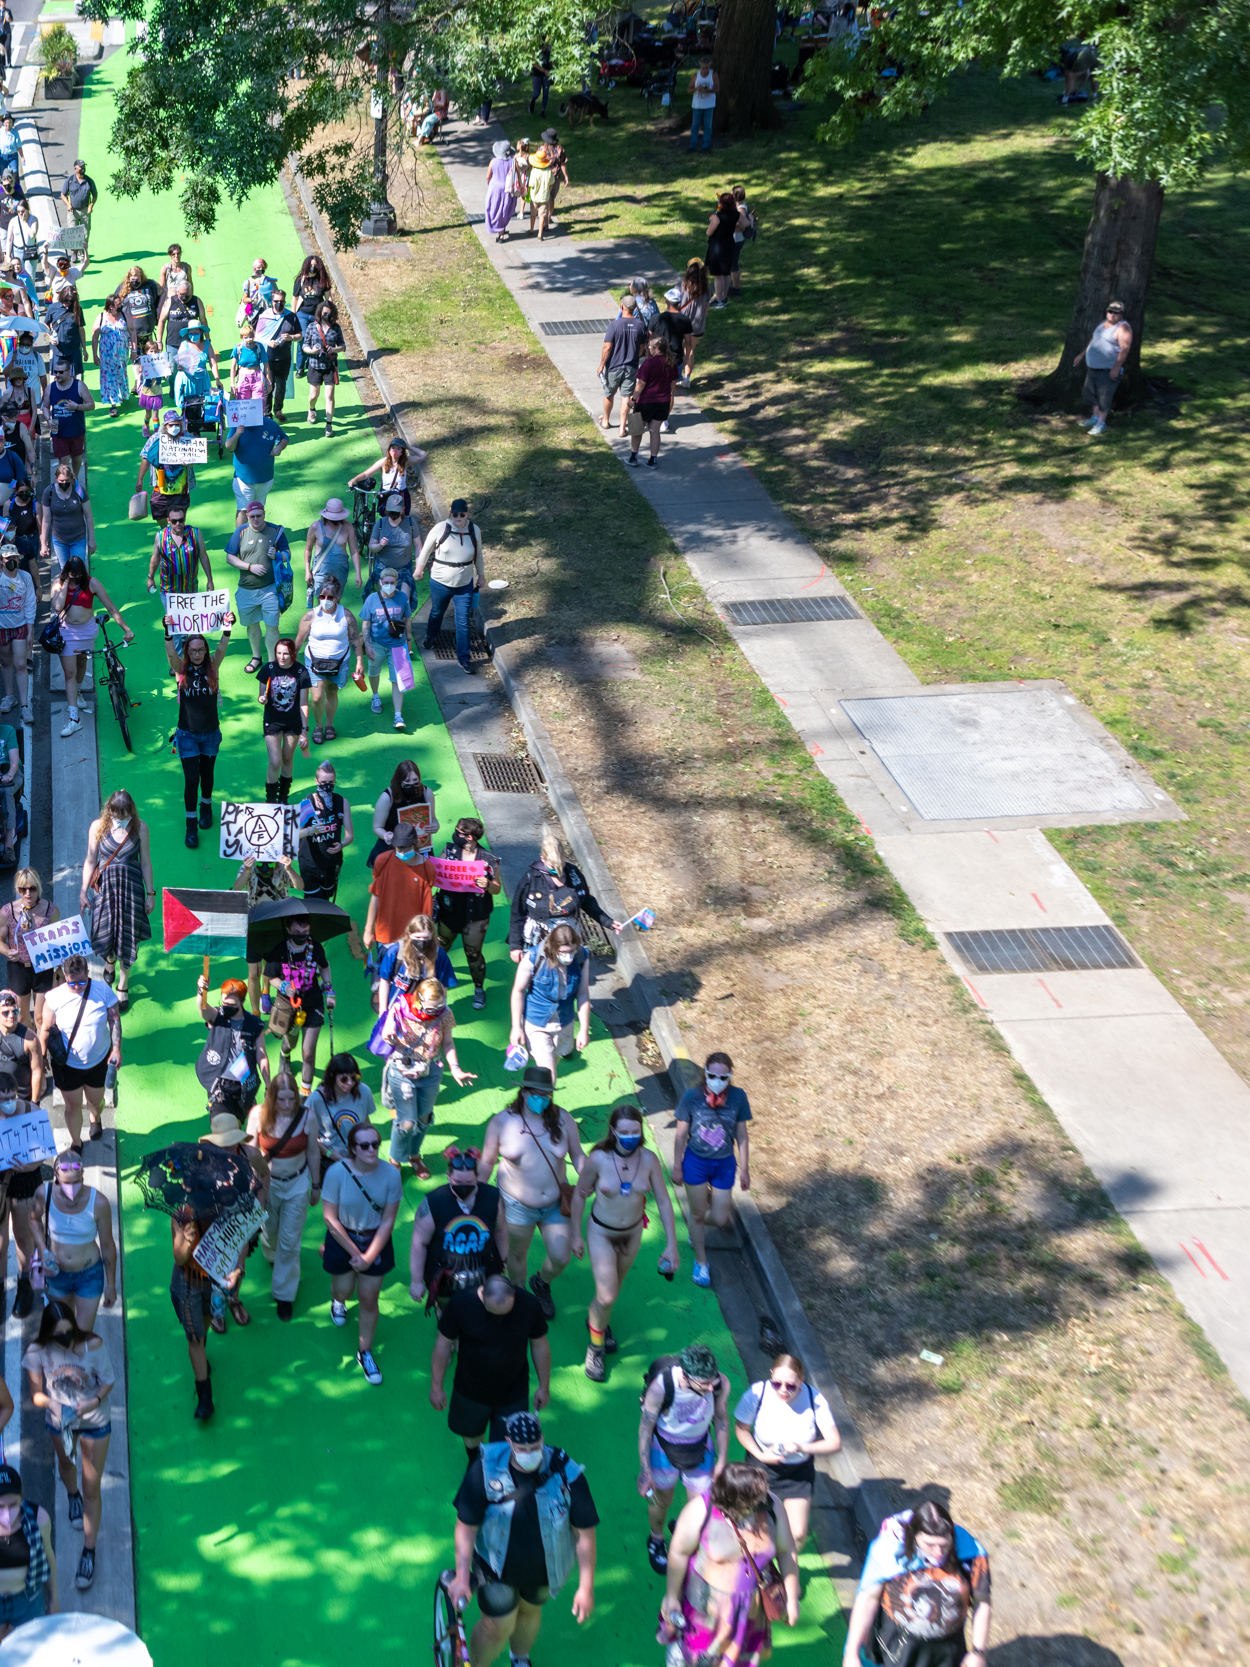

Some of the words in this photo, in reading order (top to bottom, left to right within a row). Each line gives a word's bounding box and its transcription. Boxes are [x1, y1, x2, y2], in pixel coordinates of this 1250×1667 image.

[47, 232, 65, 241] DYKE
[161, 435, 205, 447] CHRISTIAN
[168, 595, 196, 611] FREE
[202, 594, 225, 608] THE
[184, 687, 212, 697] WITCH
[312, 832, 335, 843] MAN
[444, 865, 468, 873] FREE
[435, 871, 482, 881] ALESTINE
[204, 1248, 220, 1271] YOUR
